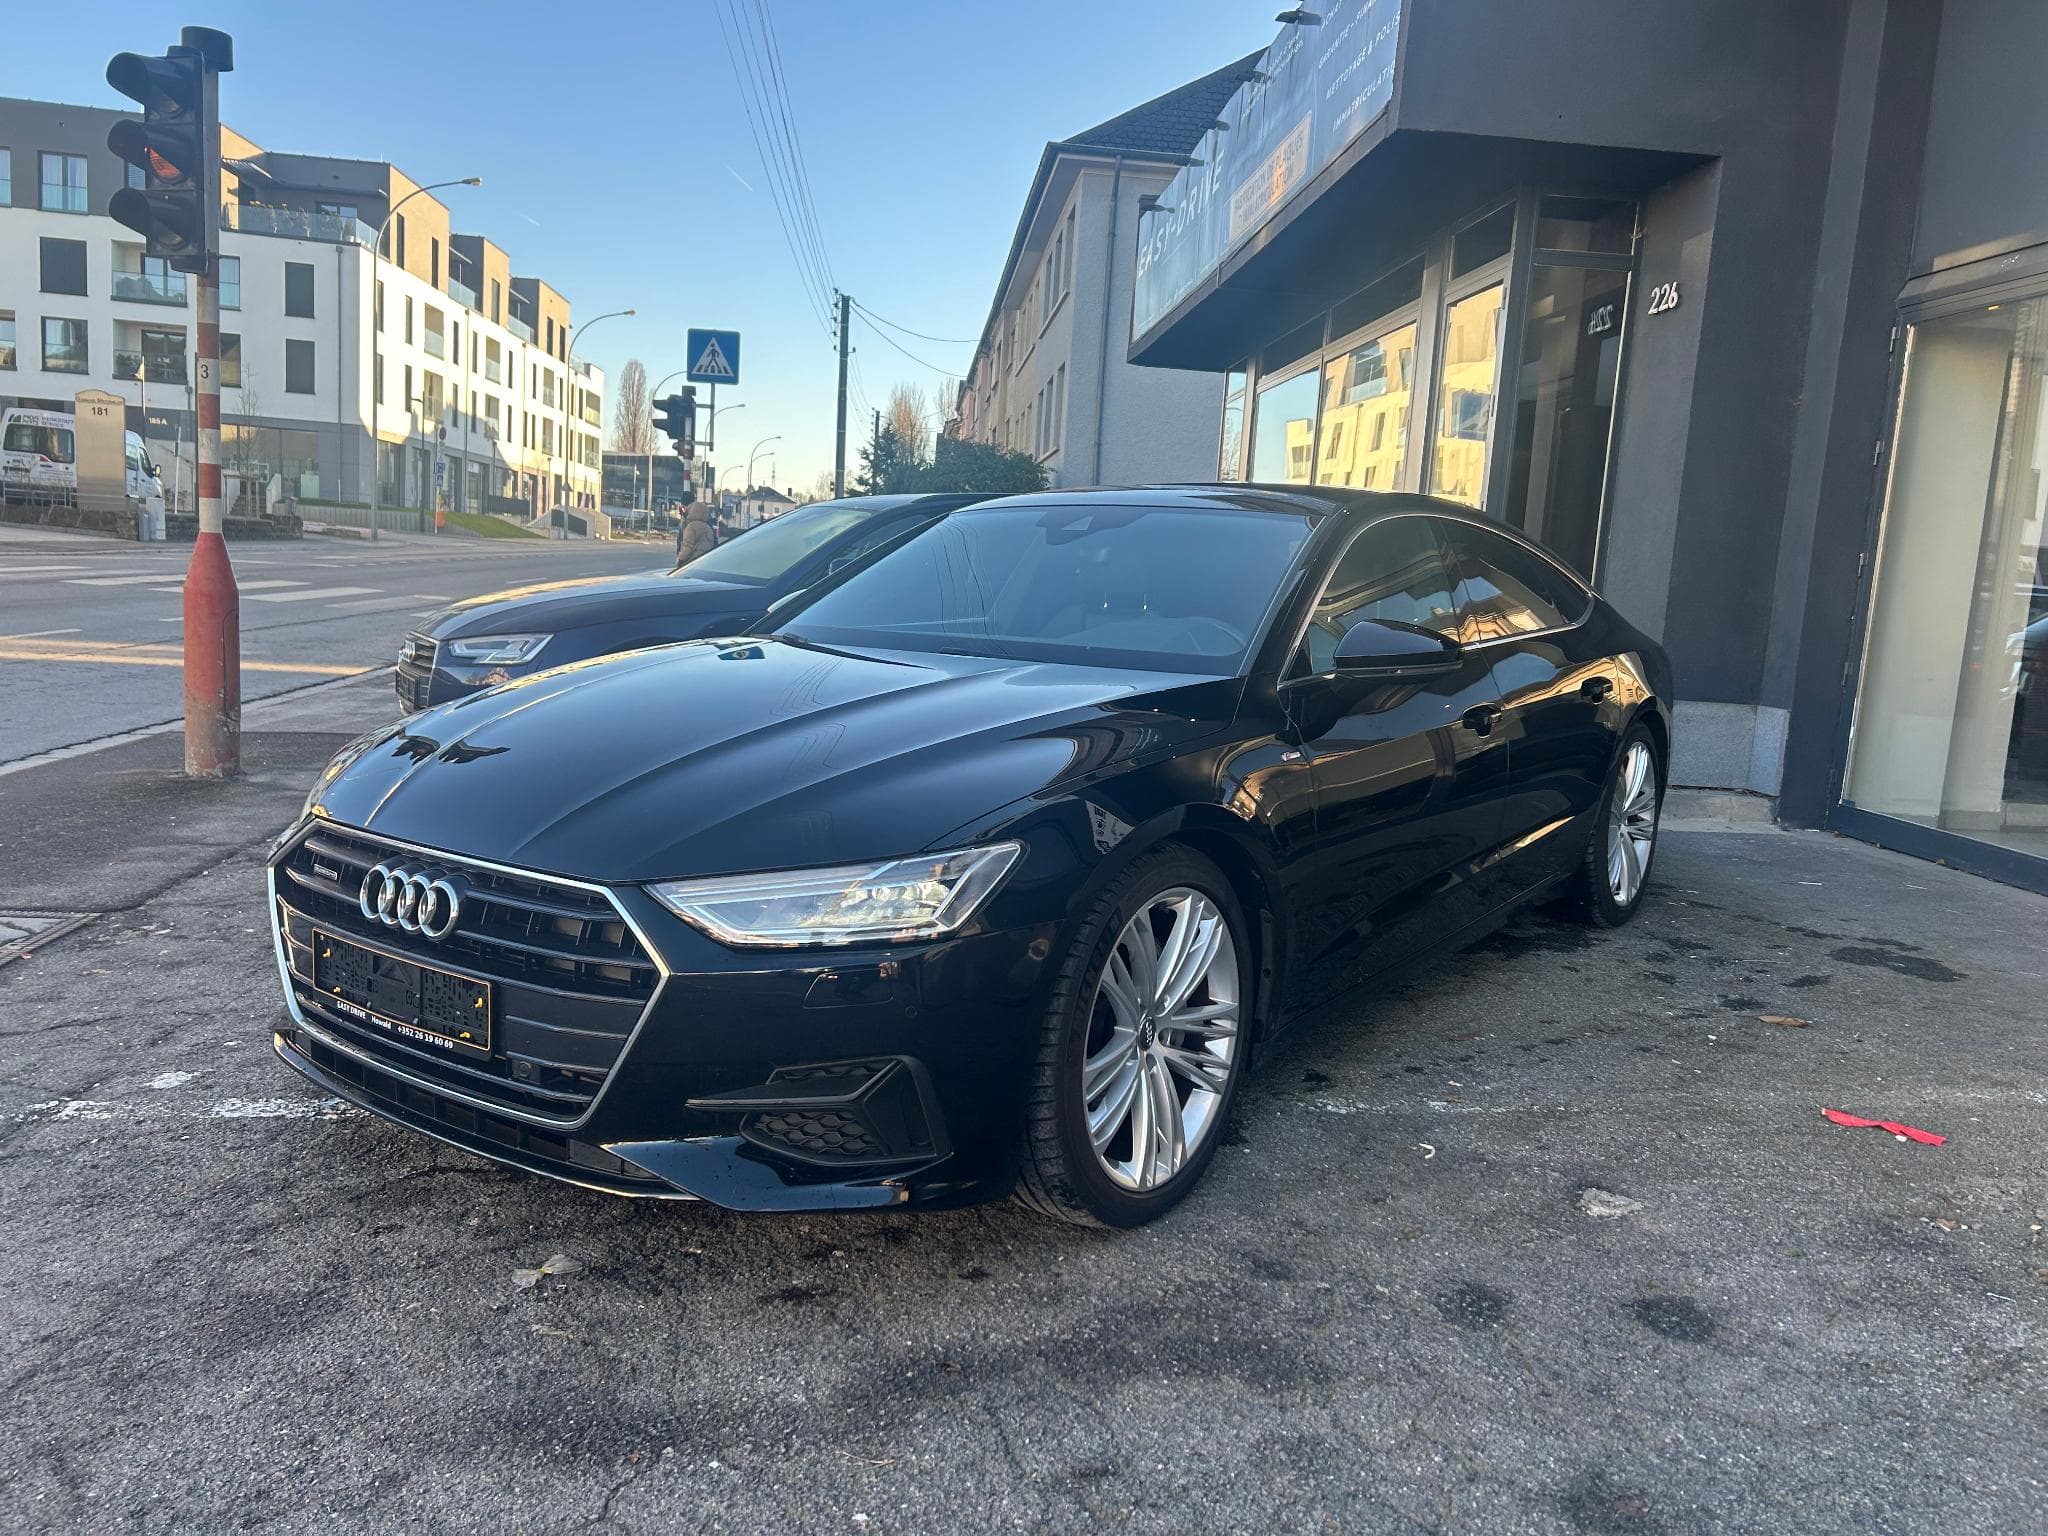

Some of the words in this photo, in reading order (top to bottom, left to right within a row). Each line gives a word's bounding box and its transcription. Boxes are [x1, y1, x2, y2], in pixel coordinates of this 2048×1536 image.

[1326, 47, 1367, 101] NETTOYAGE
[1137, 150, 1225, 278] EASY-DRIVE
[1648, 281, 1679, 315] 226
[200, 364, 209, 379] 3
[91, 406, 109, 416] 181
[350, 1006, 366, 1020] DRIVE
[397, 1025, 414, 1037] +352
[414, 1030, 424, 1040] 26
[424, 1033, 434, 1043] 19
[434, 1036, 444, 1046] 60
[444, 1040, 454, 1049] 69
